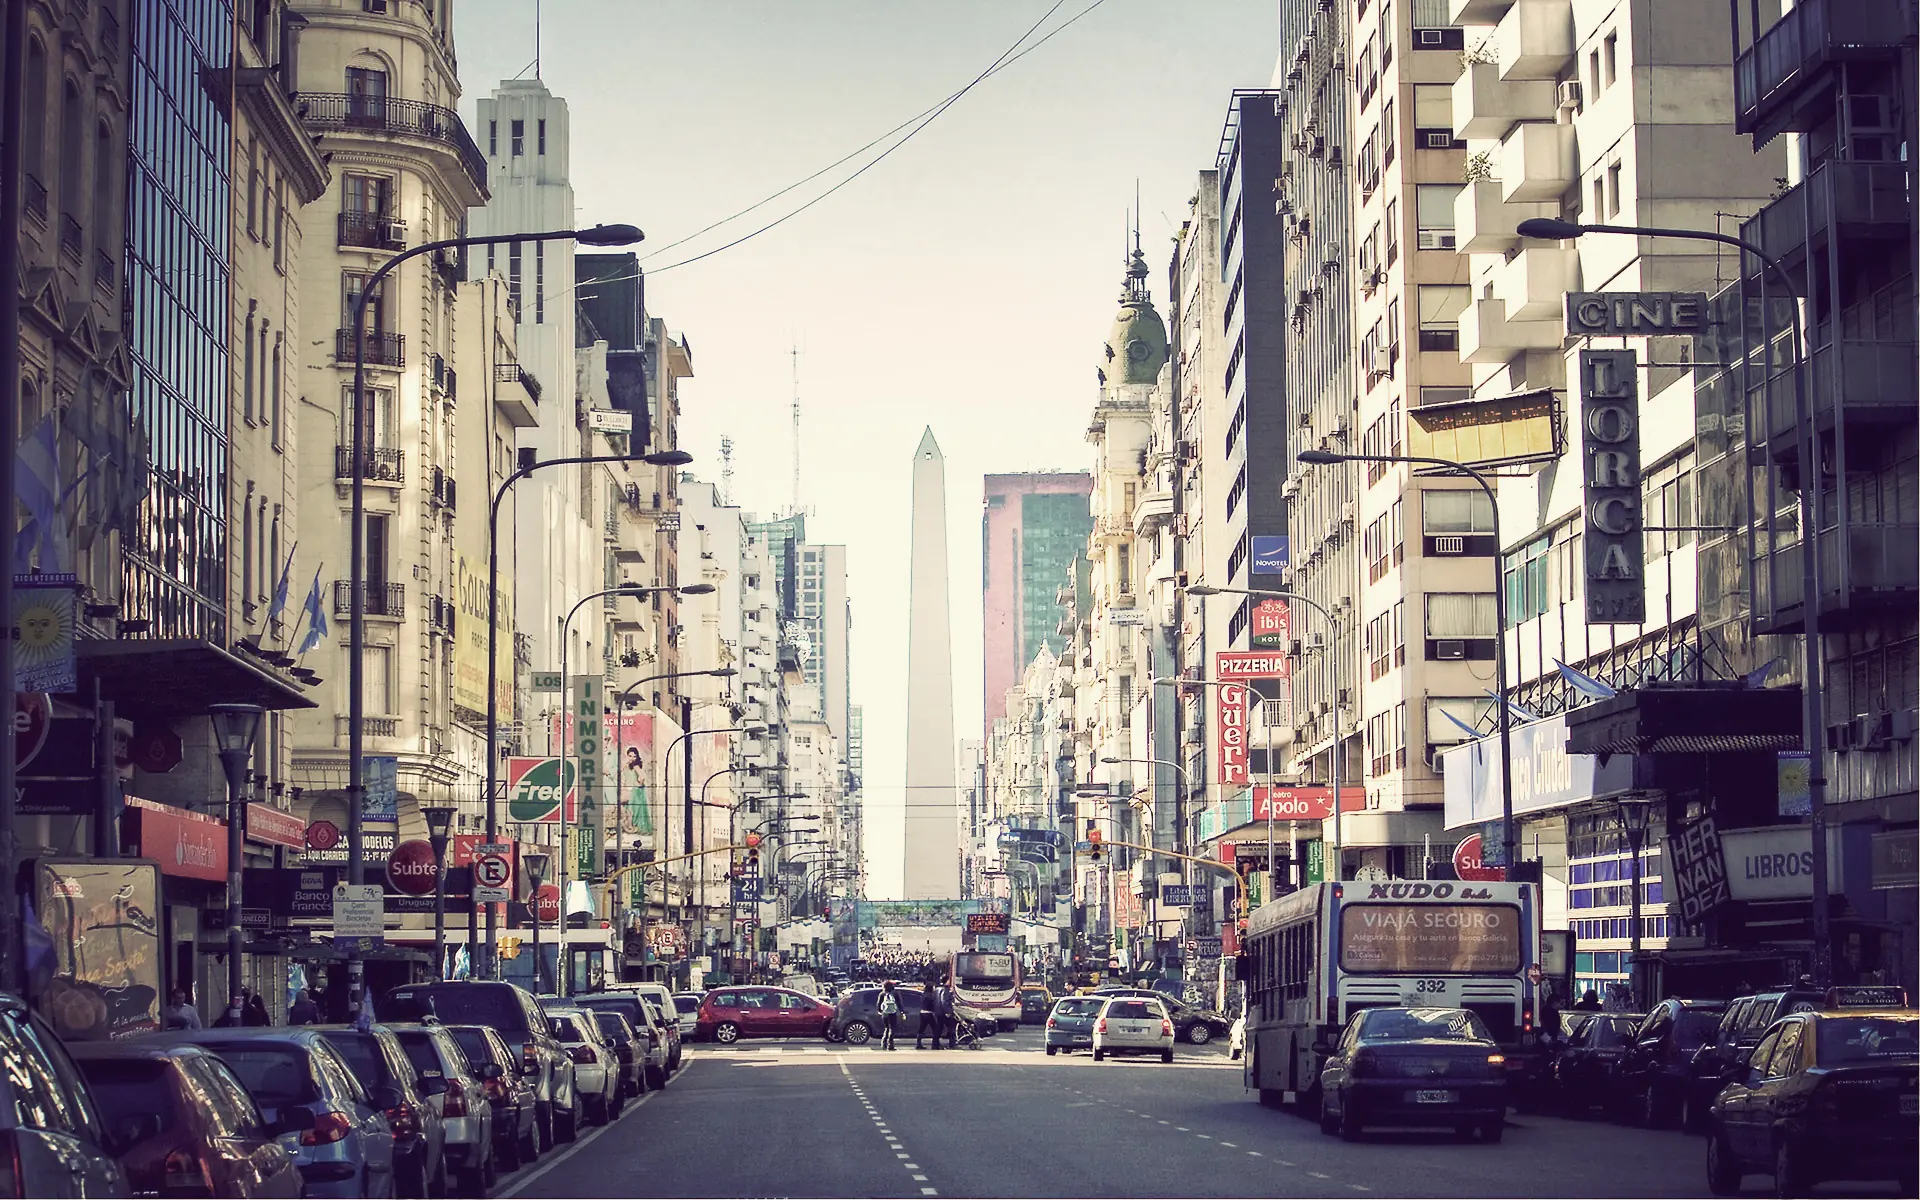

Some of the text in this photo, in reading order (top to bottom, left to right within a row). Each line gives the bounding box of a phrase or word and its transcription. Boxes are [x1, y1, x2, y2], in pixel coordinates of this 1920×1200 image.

[1576, 299, 1699, 329] CINE
[1587, 358, 1638, 580] LORCA
[459, 556, 510, 634] GOLDSEIN
[1260, 615, 1287, 629] ibis
[1219, 658, 1284, 673] PIZZERIA
[535, 677, 562, 687] LOS
[1260, 796, 1309, 816] Apolo
[1671, 818, 1719, 870] HER
[321, 851, 350, 861] CORRIENT
[392, 861, 438, 875] Subte
[1745, 852, 1813, 880] LIBROS
[1678, 851, 1723, 897] NAN
[295, 891, 330, 900] Banco
[1368, 883, 1454, 899] NUDO
[398, 899, 436, 908] Uruguay
[531, 898, 560, 909] ubt
[1683, 880, 1727, 920] DEZ
[1424, 913, 1500, 928] SEGURO
[1416, 980, 1446, 993] 332
